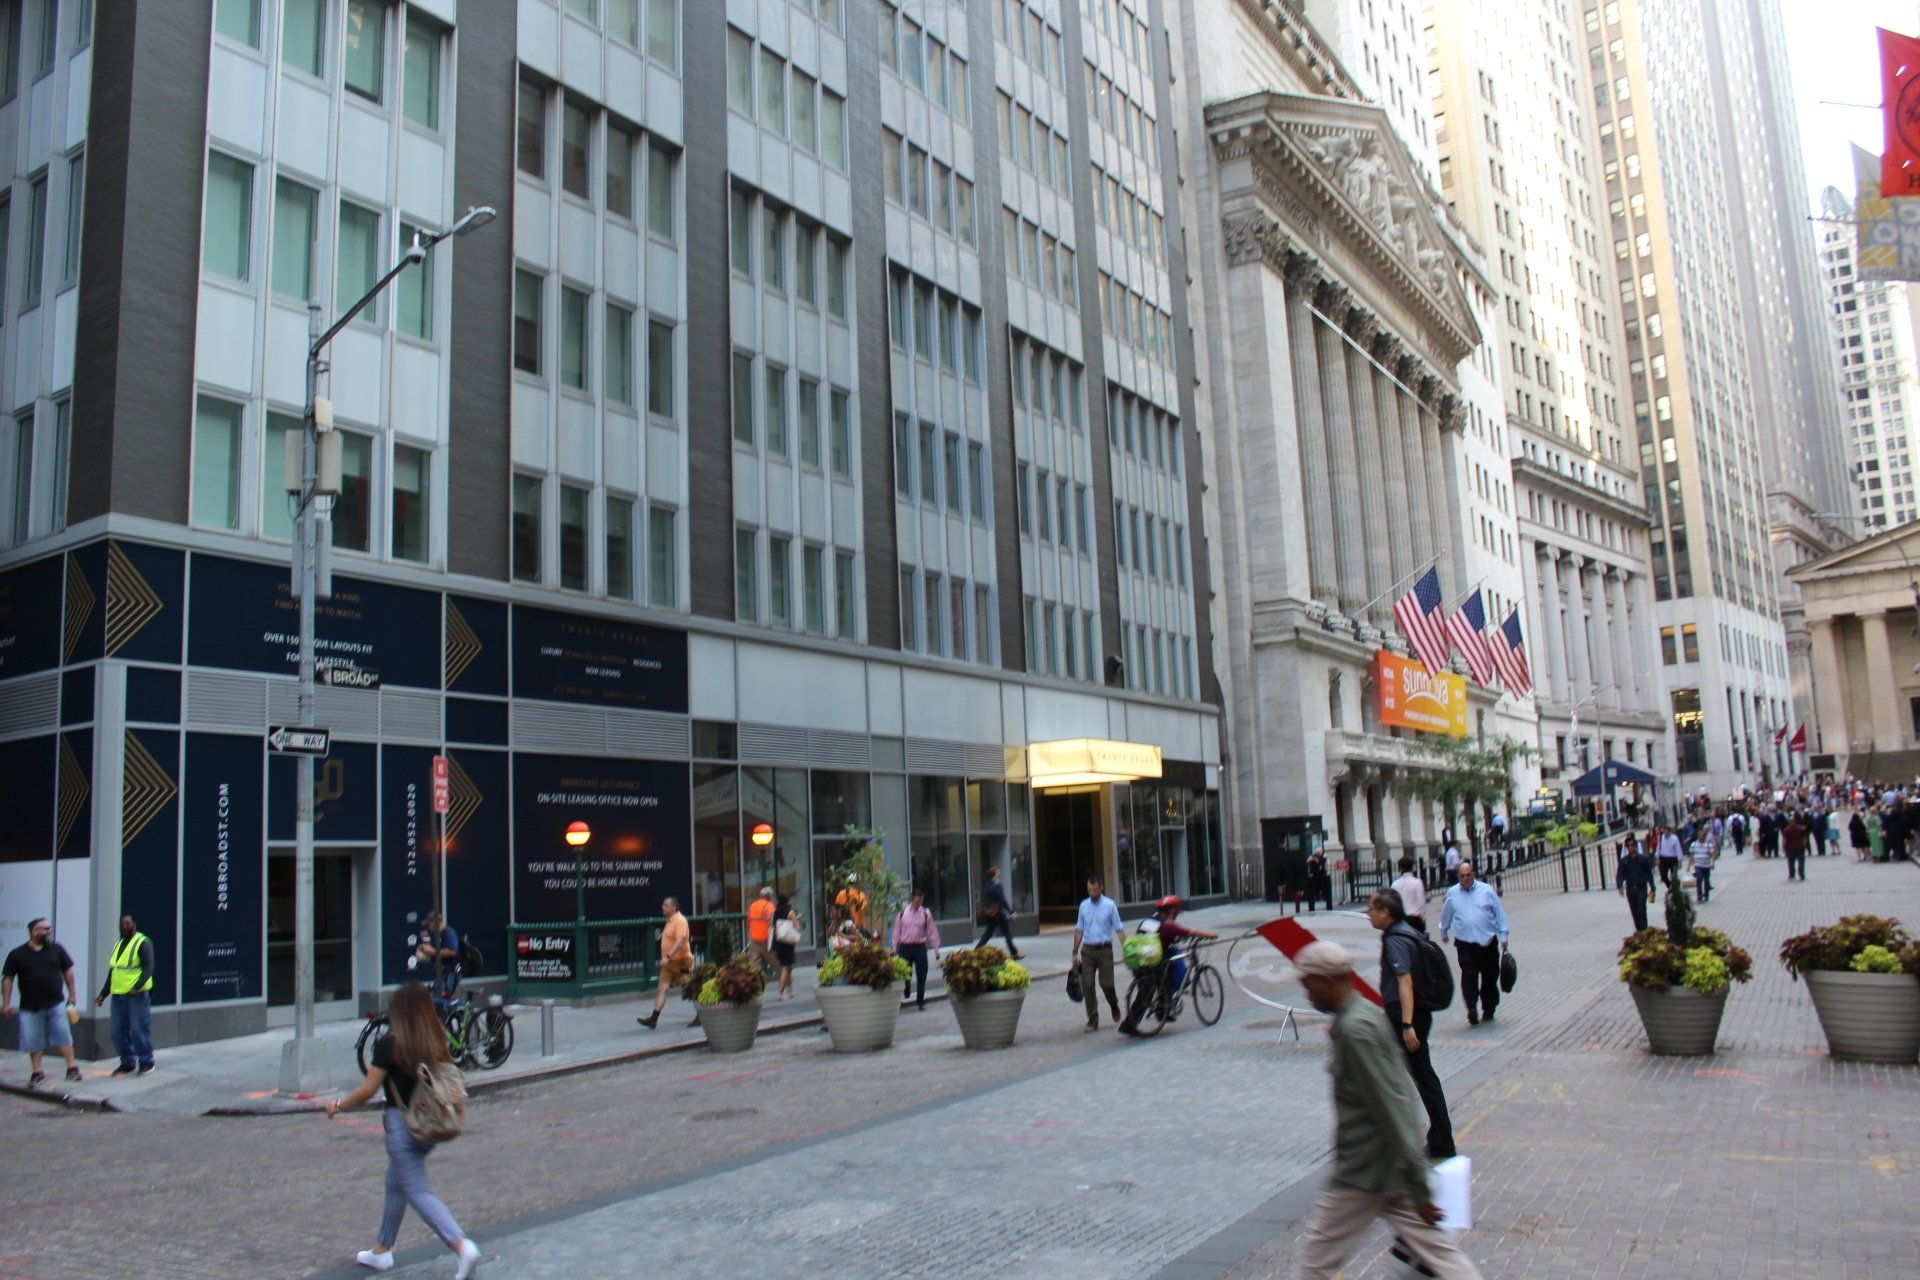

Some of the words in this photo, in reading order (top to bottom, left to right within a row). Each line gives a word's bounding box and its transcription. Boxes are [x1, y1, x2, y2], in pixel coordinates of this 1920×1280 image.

[264, 632, 284, 644] OVER
[286, 634, 300, 646] 150
[330, 640, 361, 653] LAYOUTS
[362, 644, 374, 655] FIT
[540, 646, 563, 657] LUXURY
[333, 668, 372, 686] BROAD
[585, 665, 598, 676] NOW
[599, 667, 621, 679] LEASING
[275, 732, 294, 745] ONE
[304, 733, 325, 748] WAY
[560, 777, 598, 790] IMMEDIATE
[599, 779, 640, 792] OCCUPANCY
[537, 792, 567, 805] ON-SITE
[568, 793, 597, 806] LEASING
[598, 794, 622, 807] OFFICE
[622, 795, 639, 807] NOW
[640, 796, 658, 808] OPEN
[217, 783, 230, 911] 20BROADST.COM
[528, 861, 556, 873] YOU'RE
[557, 861, 589, 872] WALKG
[590, 861, 600, 871] TO
[601, 861, 614, 871] THE
[615, 860, 642, 871] SUBWAY
[643, 860, 663, 871] WHEN
[544, 878, 560, 889] YOU
[561, 878, 586, 889] COUD
[588, 877, 597, 887] BE
[597, 876, 619, 887] HOME
[529, 936, 543, 951] No
[545, 936, 571, 952] Entry
